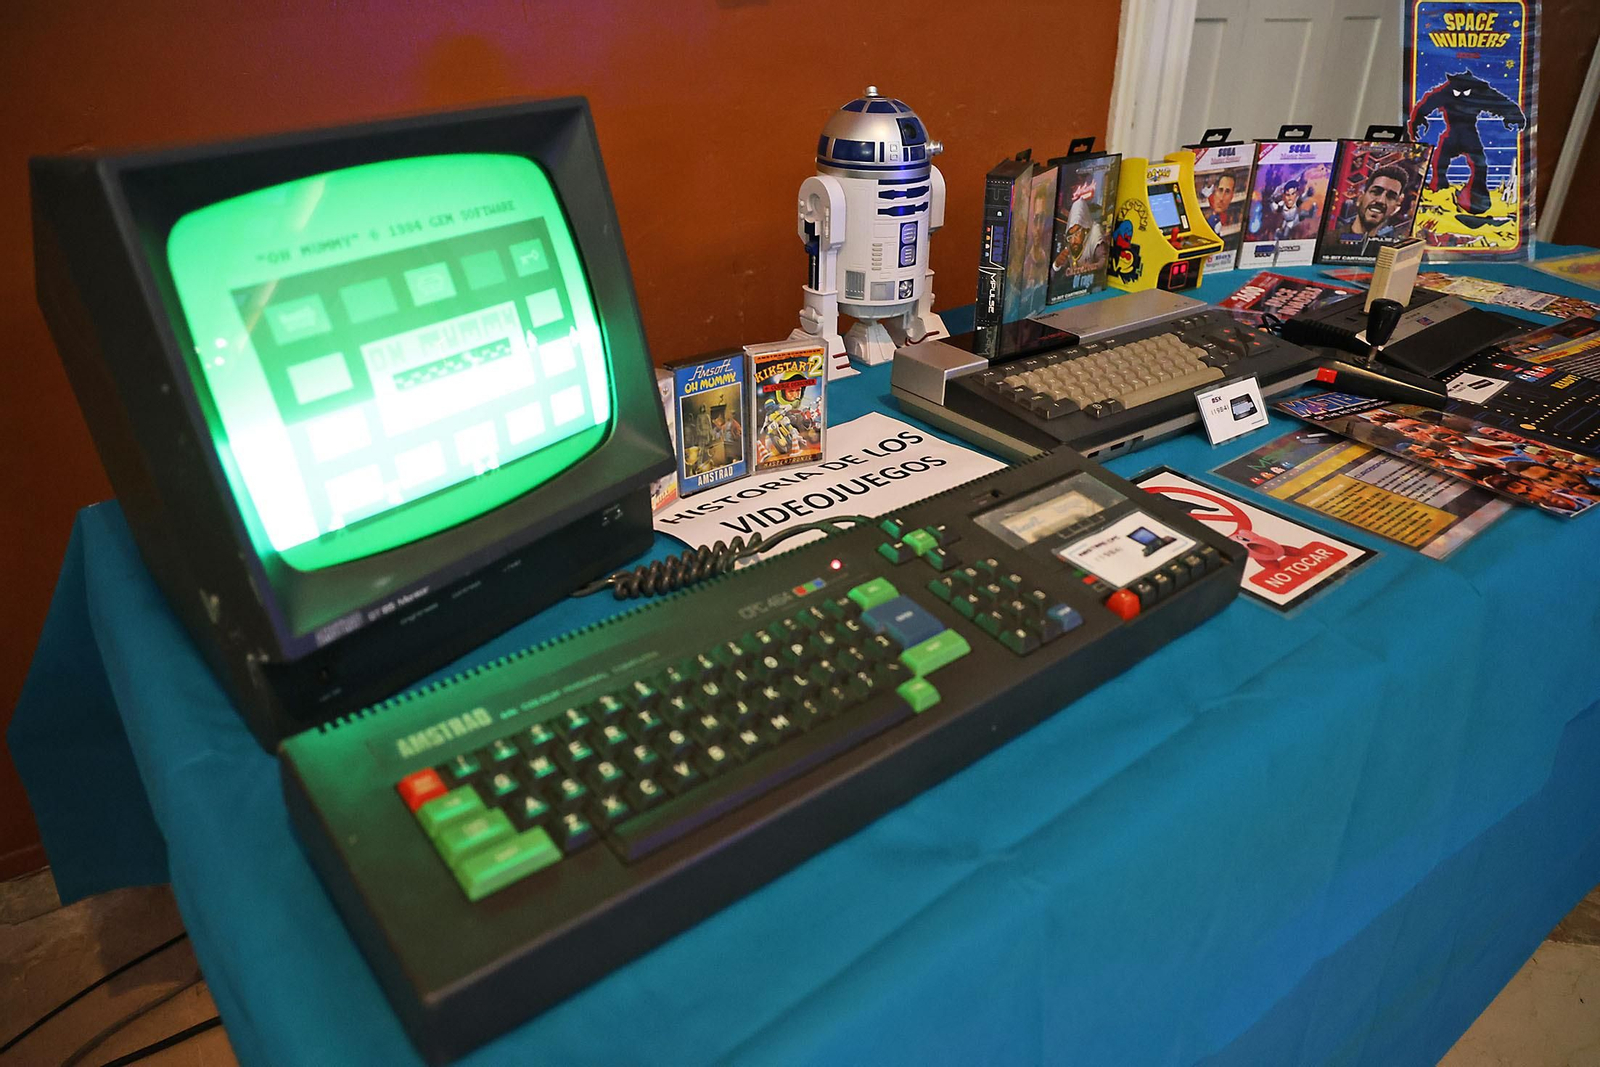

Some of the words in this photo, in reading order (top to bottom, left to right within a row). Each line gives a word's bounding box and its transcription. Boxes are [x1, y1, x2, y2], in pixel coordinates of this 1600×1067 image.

[1443, 12, 1499, 31] SPACE
[1428, 32, 1512, 48] INVADERS
[1218, 147, 1236, 157] SEGA
[1289, 144, 1311, 153] SEGA
[428, 212, 455, 228] GEM
[459, 199, 516, 220] SOFTWARE
[754, 360, 815, 384] KIKSTART
[808, 354, 824, 376] 2
[684, 381, 698, 394] OH
[700, 371, 736, 390] MUMMY
[660, 470, 825, 525] HISTORIA
[819, 453, 869, 471] DE
[863, 430, 925, 456] LOS
[697, 465, 735, 487] AMSTRAD
[719, 455, 948, 535] VIDEOJUEGOS
[1264, 571, 1291, 589] NO
[1284, 548, 1335, 580] TOCAR
[395, 706, 493, 759] AMSTRAD
